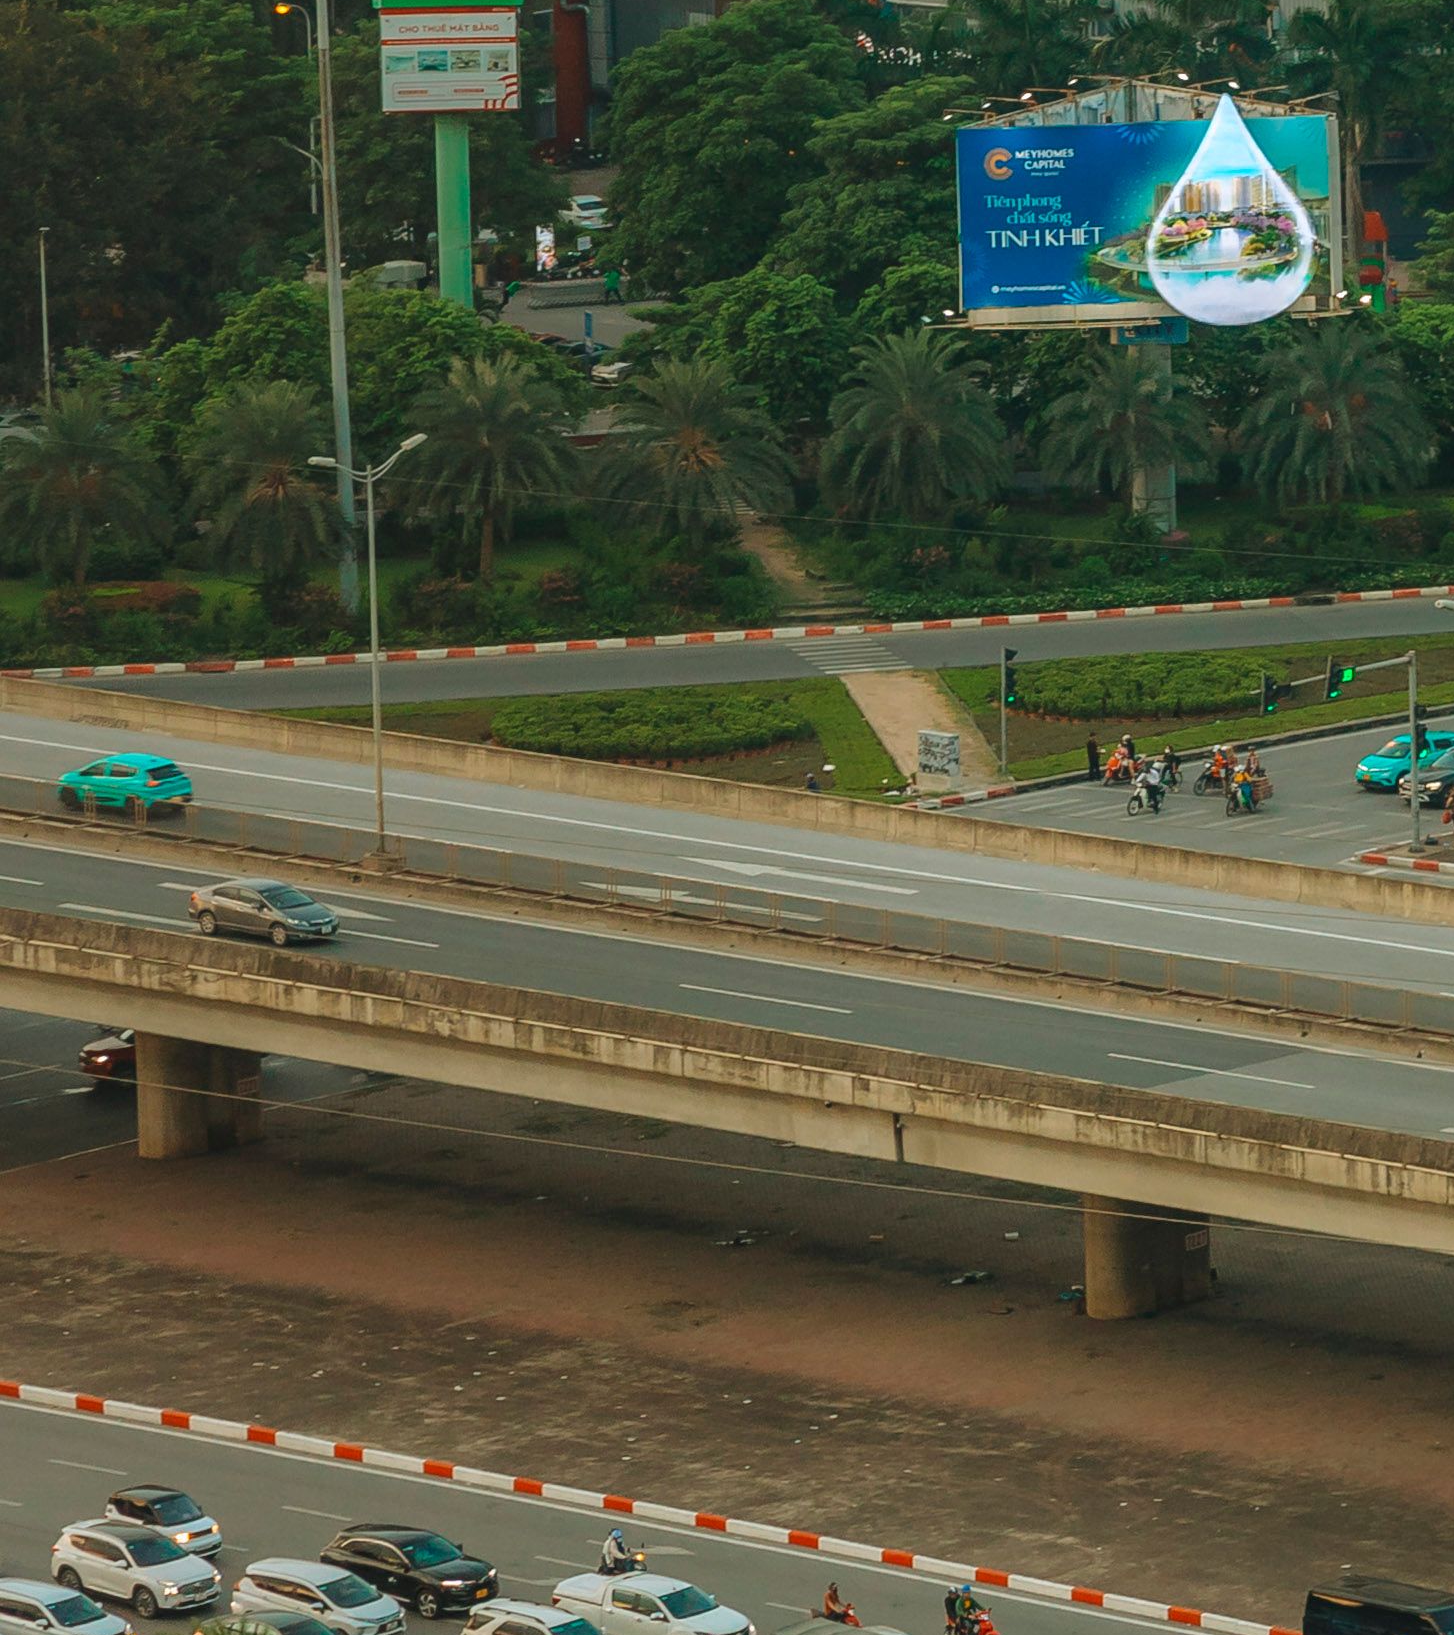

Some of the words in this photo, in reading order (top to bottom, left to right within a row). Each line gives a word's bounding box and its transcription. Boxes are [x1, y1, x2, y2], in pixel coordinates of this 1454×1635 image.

[1015, 148, 1074, 159] MEYHOMES
[1024, 159, 1066, 170] CAPITAL
[1018, 194, 1062, 211] phong
[1038, 210, 1072, 227] sống
[985, 230, 1040, 248] TINH
[1045, 221, 1104, 247] KHIẾT
